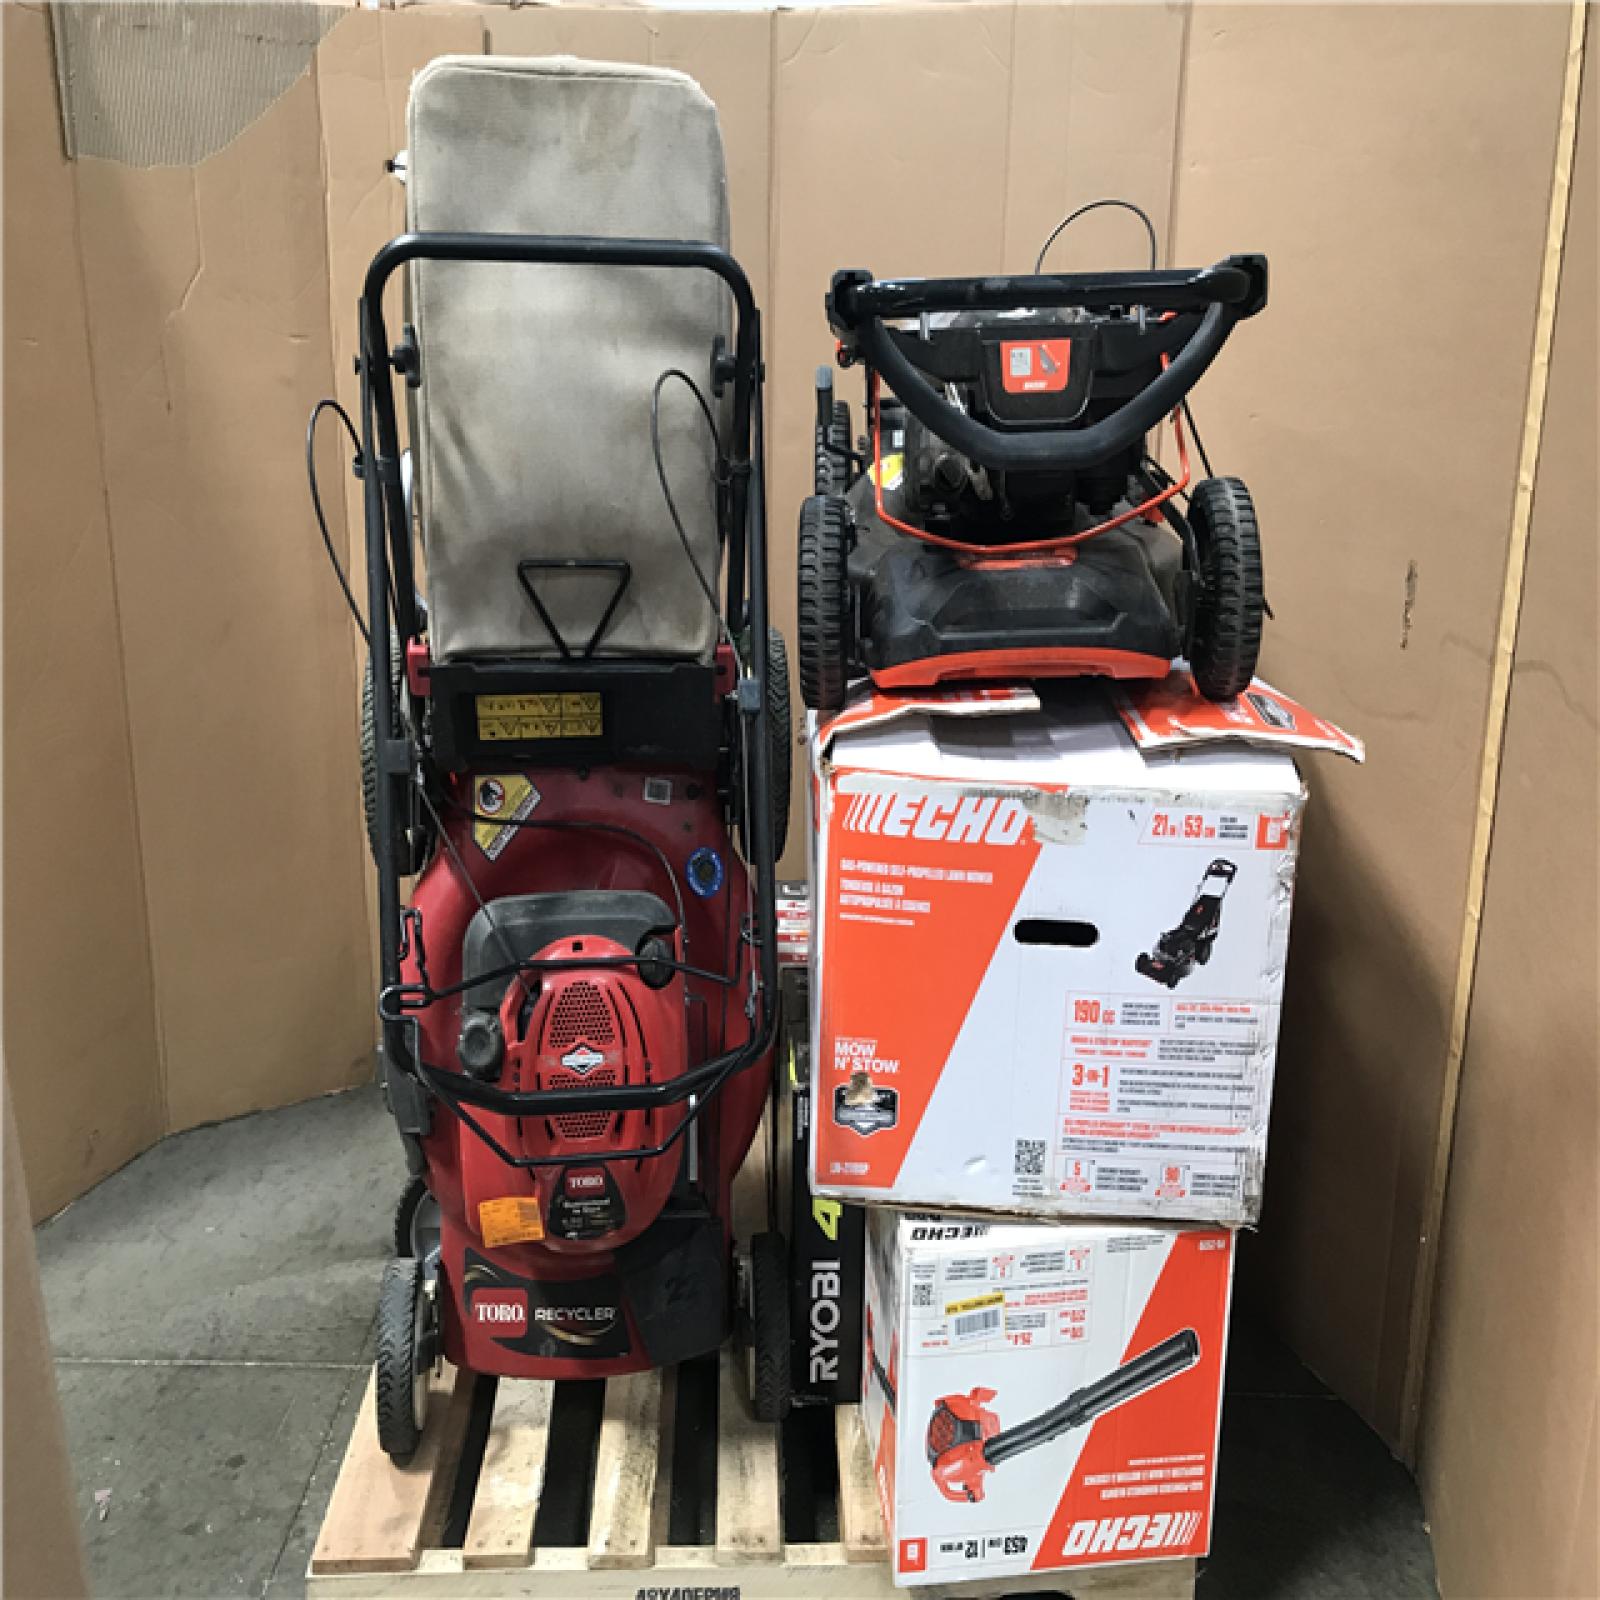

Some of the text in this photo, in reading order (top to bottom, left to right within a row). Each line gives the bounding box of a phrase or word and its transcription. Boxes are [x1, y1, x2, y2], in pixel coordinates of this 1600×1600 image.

[880, 793, 1031, 846] ECHO
[1152, 812, 1169, 836] 21
[1184, 815, 1203, 838] 53
[1074, 999, 1101, 1024] 190
[834, 1040, 877, 1057] MOW
[569, 1174, 604, 1189] TORO
[909, 1226, 976, 1241] ECHO
[809, 1197, 844, 1383] RYOBI 4
[475, 1302, 616, 1322] TORO RECYCLER
[1062, 1512, 1172, 1556] ECHO
